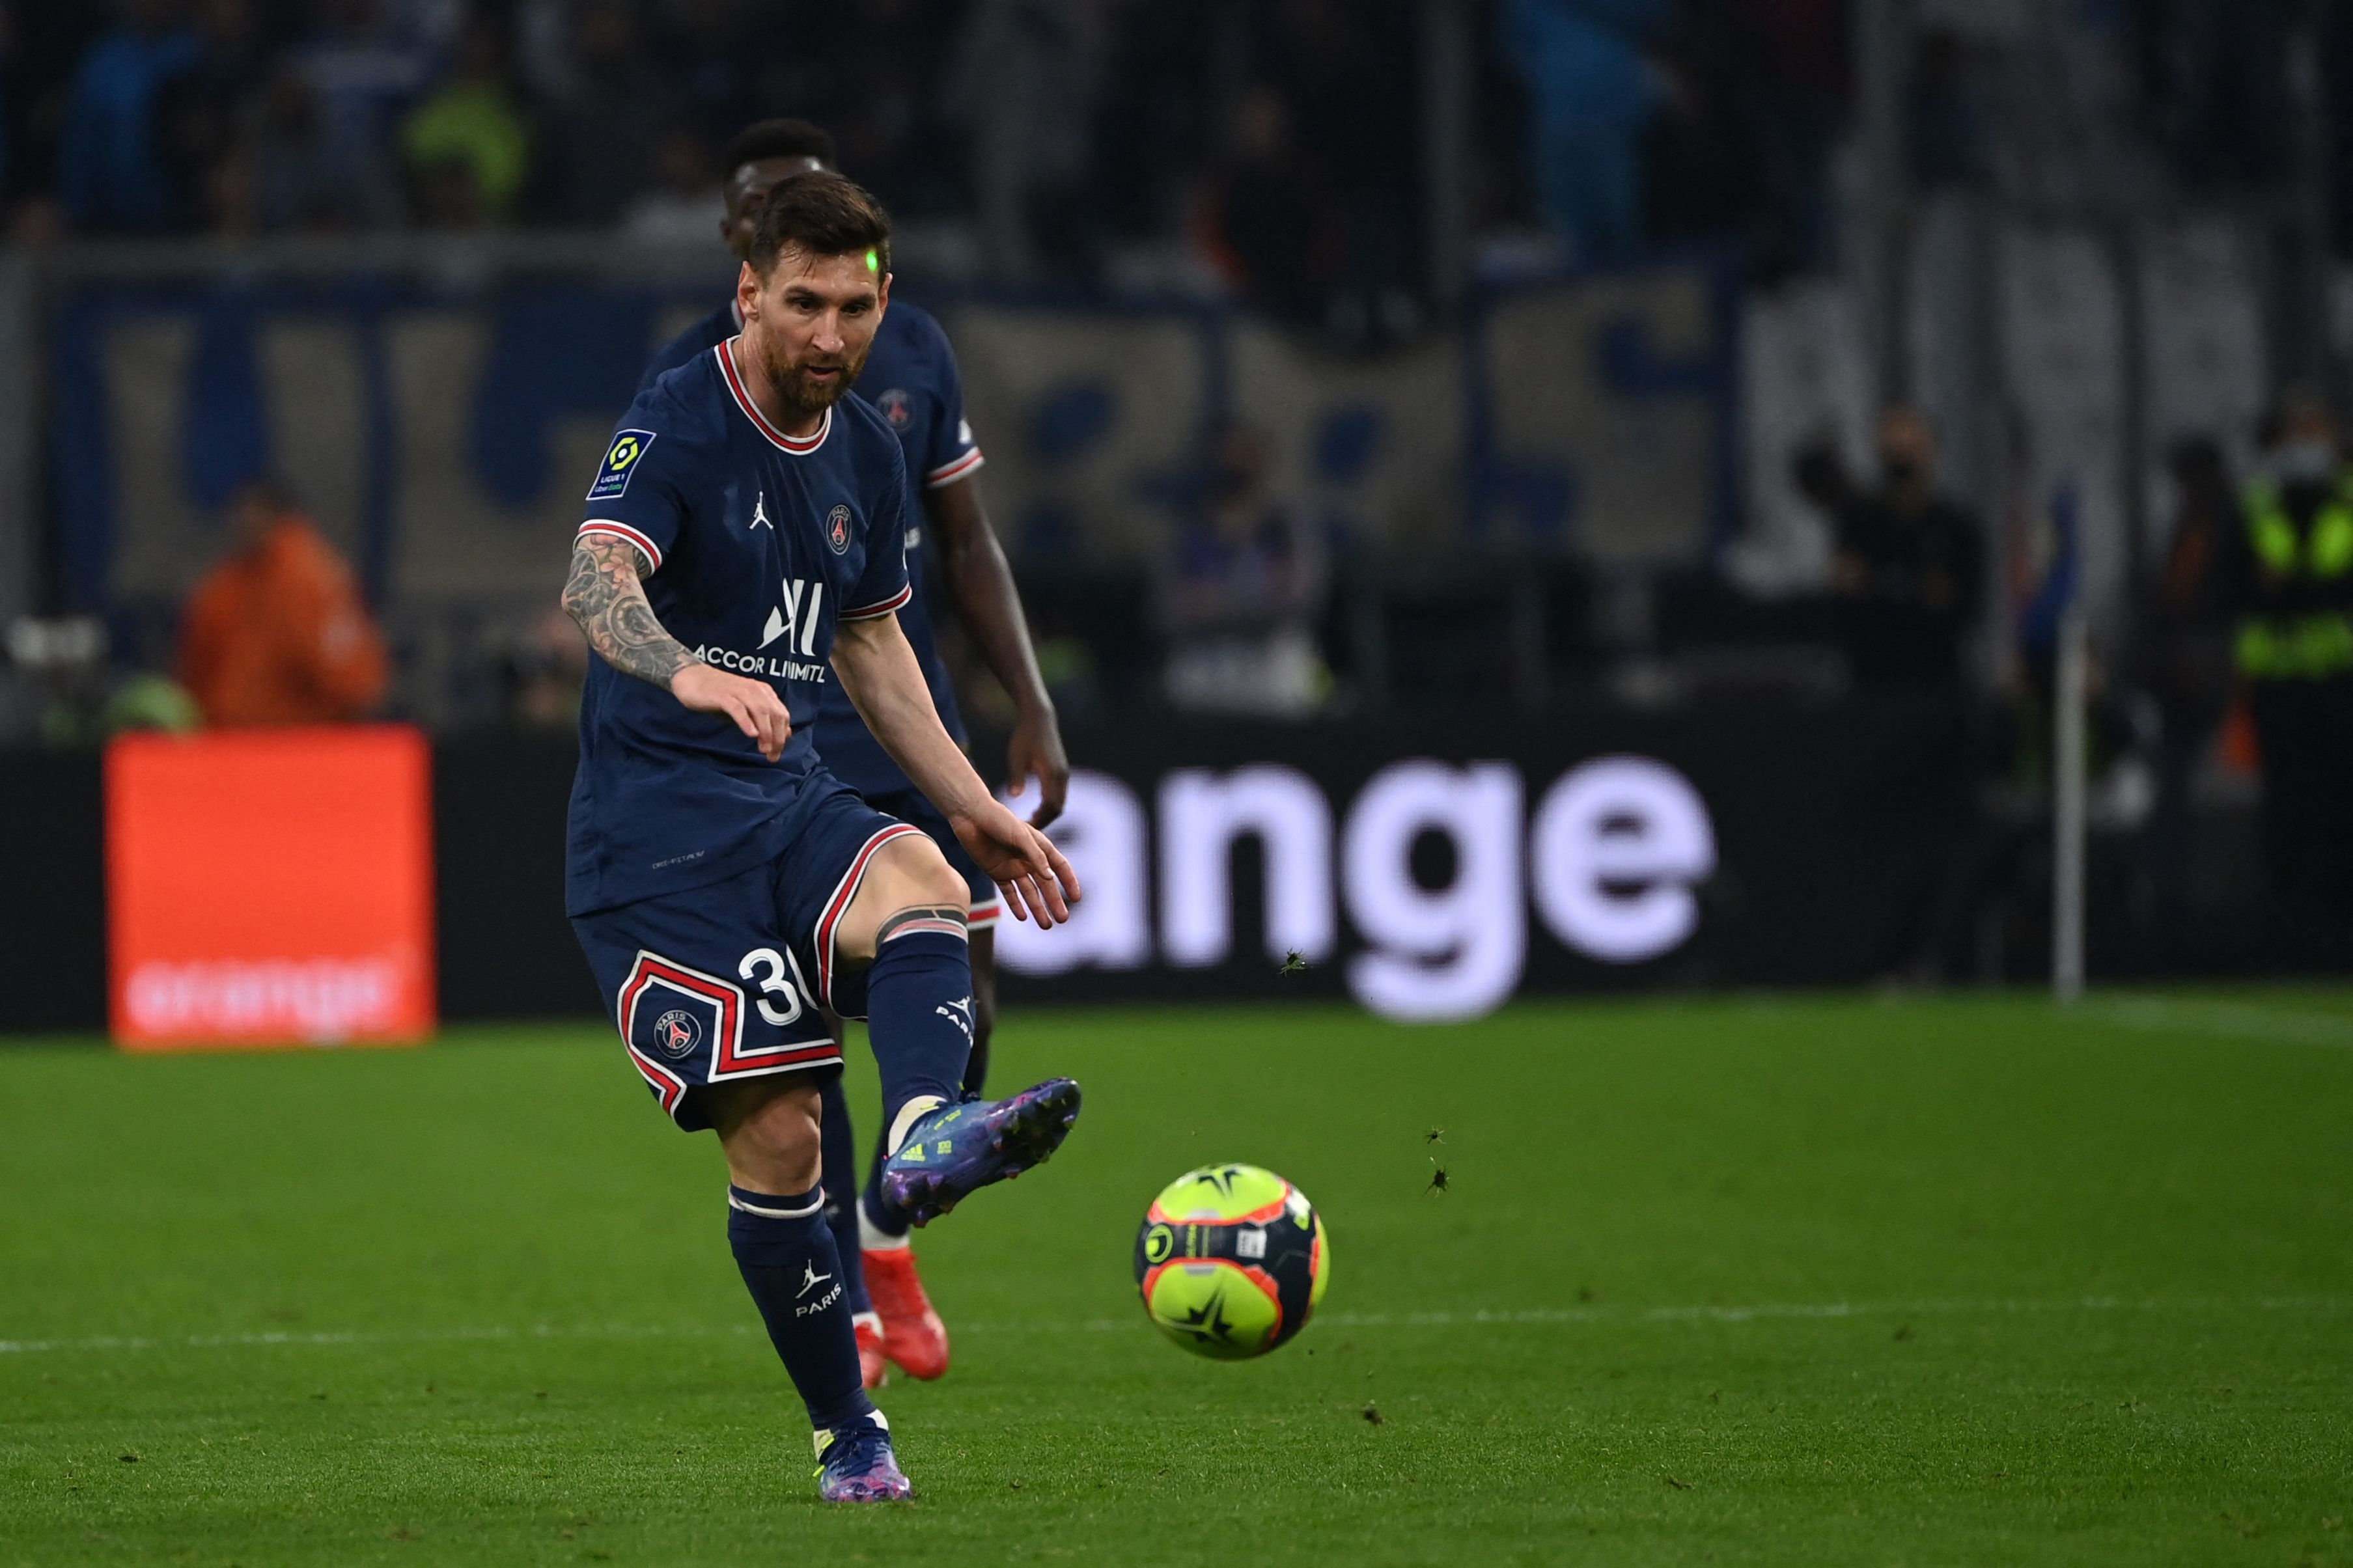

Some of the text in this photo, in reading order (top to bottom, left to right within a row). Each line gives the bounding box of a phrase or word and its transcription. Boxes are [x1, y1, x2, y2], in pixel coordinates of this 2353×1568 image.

[695, 644, 765, 673] ACCOR
[992, 758, 1719, 1023] ange
[656, 1012, 687, 1031] PARIS
[796, 1282, 842, 1317] PARIS
